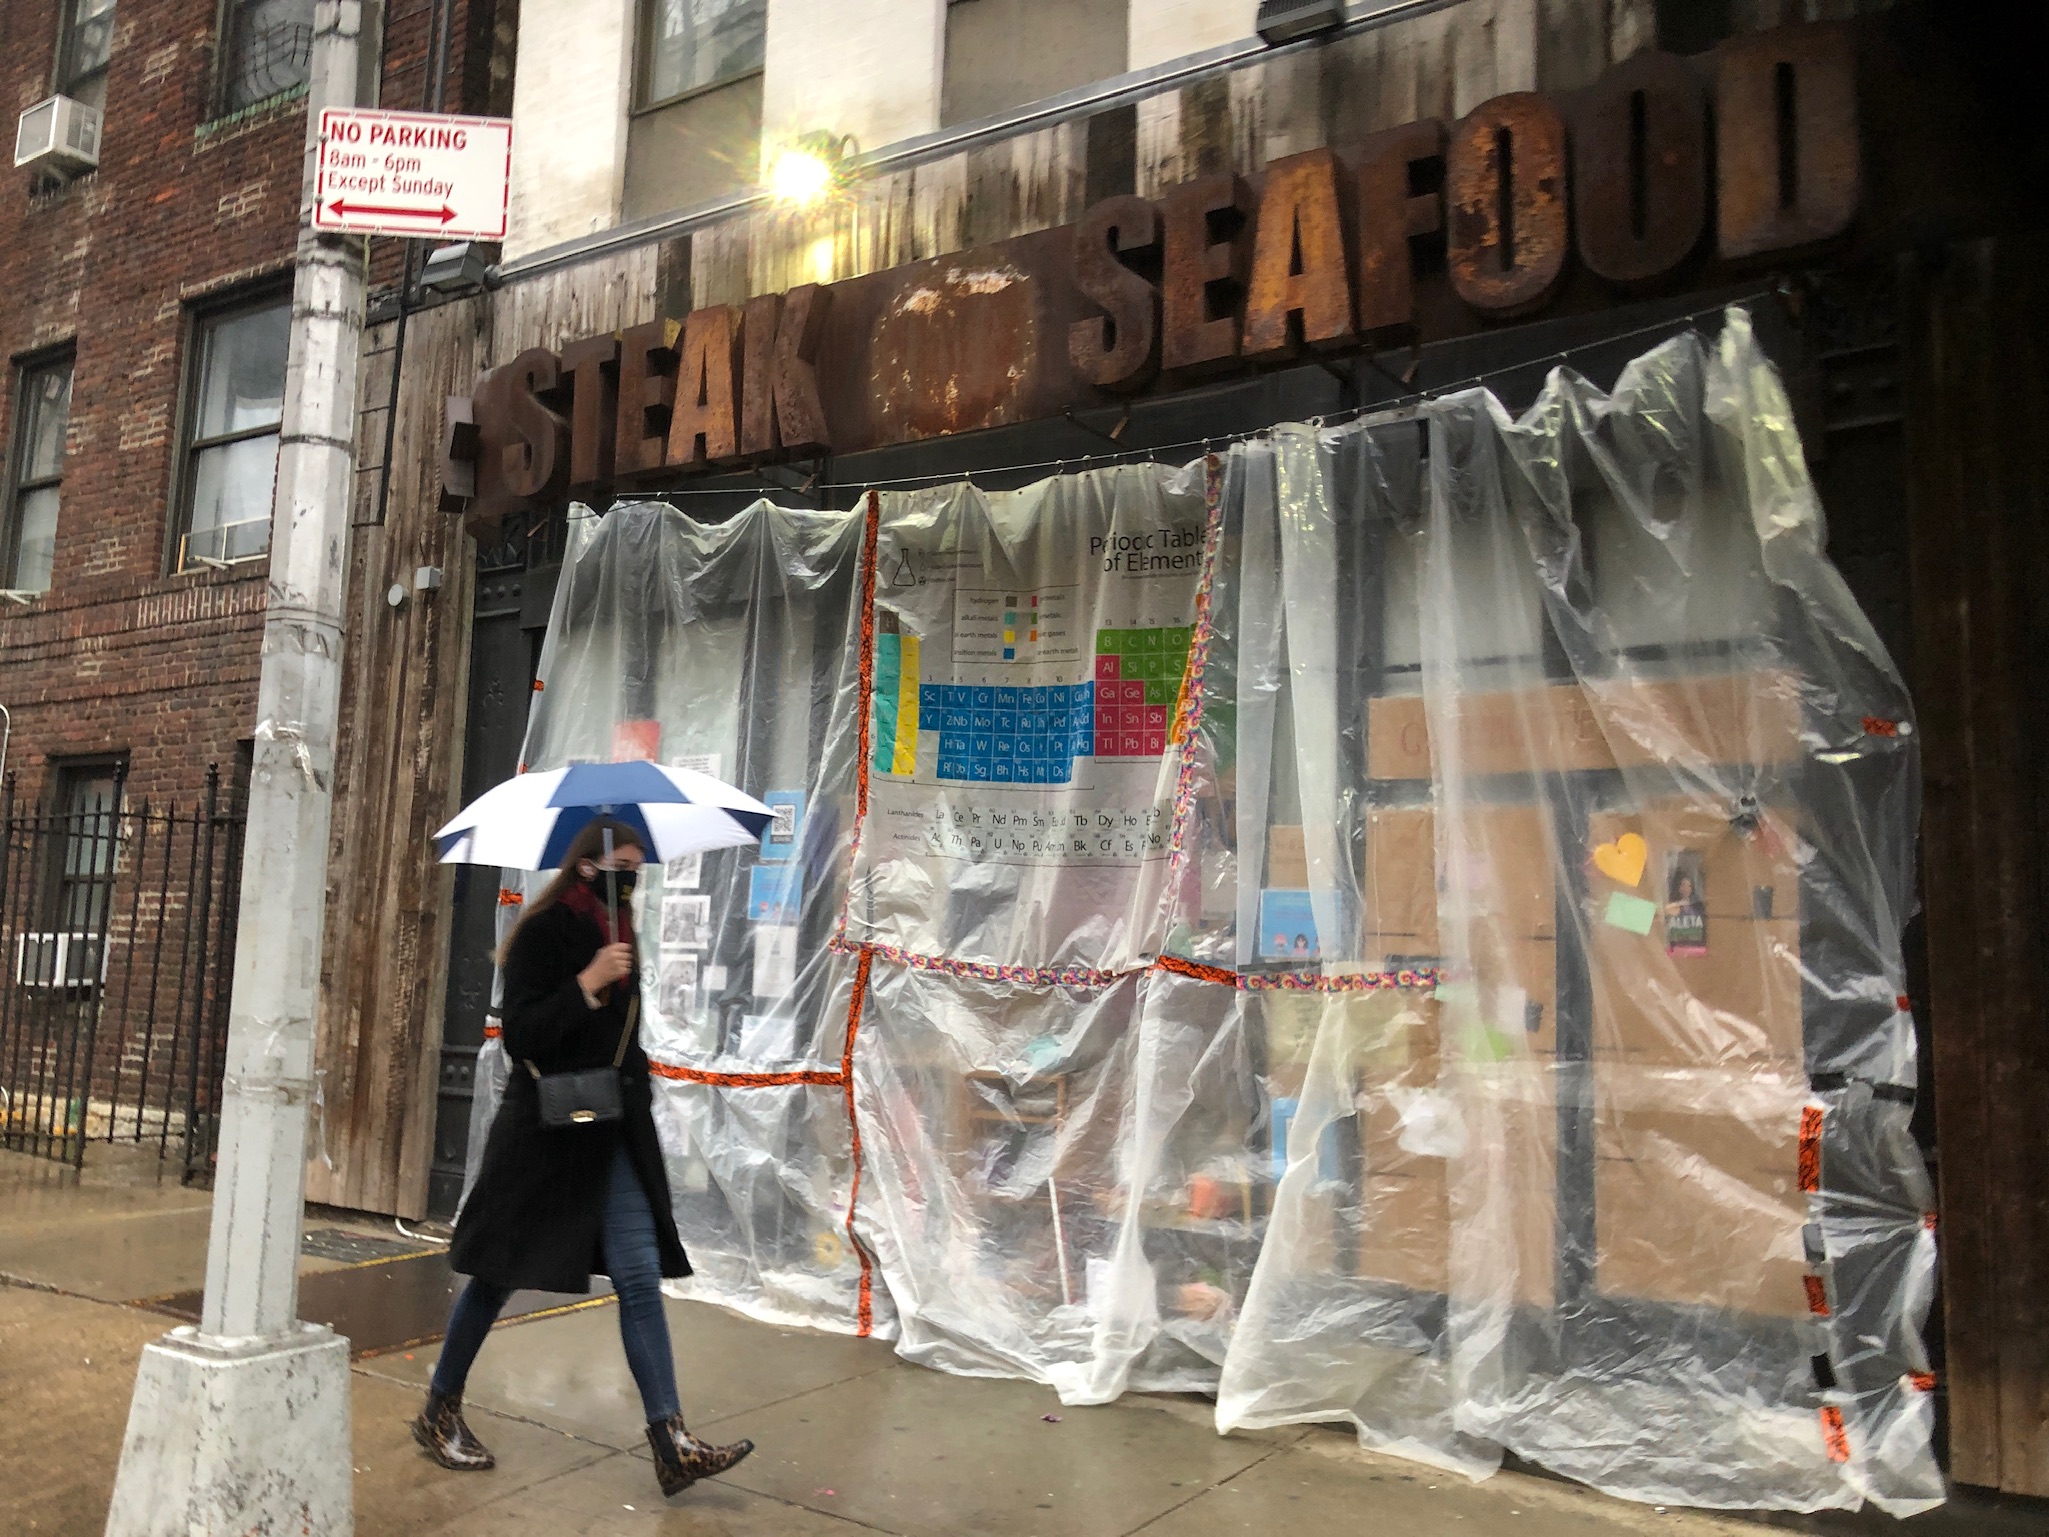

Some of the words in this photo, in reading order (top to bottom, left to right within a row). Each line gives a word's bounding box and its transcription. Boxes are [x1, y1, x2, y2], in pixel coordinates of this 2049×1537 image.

[331, 120, 361, 143] NO
[369, 124, 467, 151] PARKING
[329, 149, 366, 168] 8am
[384, 153, 421, 174] 6pm
[328, 171, 389, 196] Except
[392, 175, 454, 200] Sunday
[498, 285, 828, 497] STEAK
[1068, 24, 1860, 386] SEAFOOD
[1104, 552, 1122, 572] of
[1104, 636, 1111, 646] B
[1148, 635, 1156, 645] N
[1173, 634, 1181, 645] O
[1103, 662, 1114, 672] Al
[1174, 660, 1180, 671] S
[924, 690, 935, 701] Sc
[957, 692, 966, 702] V
[978, 692, 988, 703] Cr
[998, 693, 1015, 704] Mn
[1022, 694, 1032, 704] Fe
[1053, 692, 1065, 703] Ni
[1100, 687, 1115, 698] Ga
[1124, 687, 1140, 698] Ge
[926, 715, 933, 724] Y
[954, 715, 968, 726] Nb
[974, 717, 991, 727] Mo
[1001, 717, 1010, 728] Tc
[1053, 716, 1066, 727] Pd
[1102, 713, 1112, 724] In
[1126, 713, 1139, 724] Sn
[1149, 712, 1163, 723] Sb
[976, 740, 987, 751] W
[998, 741, 1010, 751] Re
[1019, 741, 1030, 752] Os
[1054, 741, 1063, 752] Pt
[1125, 738, 1138, 749] Pb
[1150, 738, 1159, 749] Bi
[974, 764, 986, 777] Sg
[996, 765, 1008, 775] Bh
[1018, 765, 1029, 776] Hs
[1053, 766, 1063, 777] Ds
[887, 808, 924, 818] Lanthanides
[936, 809, 944, 819] La
[953, 812, 964, 822] Ce
[972, 813, 981, 823] Pr
[992, 814, 1006, 825] Nd
[1013, 815, 1027, 825] Pm
[1033, 816, 1044, 827] Sm
[1074, 815, 1088, 826] Tb
[1098, 815, 1113, 828] Dy
[1124, 815, 1137, 826] Ho
[893, 833, 920, 841] Actinides
[951, 834, 962, 845] Th
[971, 837, 980, 848] Pa
[994, 838, 1002, 849] U
[1012, 839, 1025, 852] Np
[1033, 840, 1042, 851] Pu
[1074, 840, 1087, 851] Bk
[1100, 840, 1112, 851] Cf
[1125, 840, 1133, 851] Es
